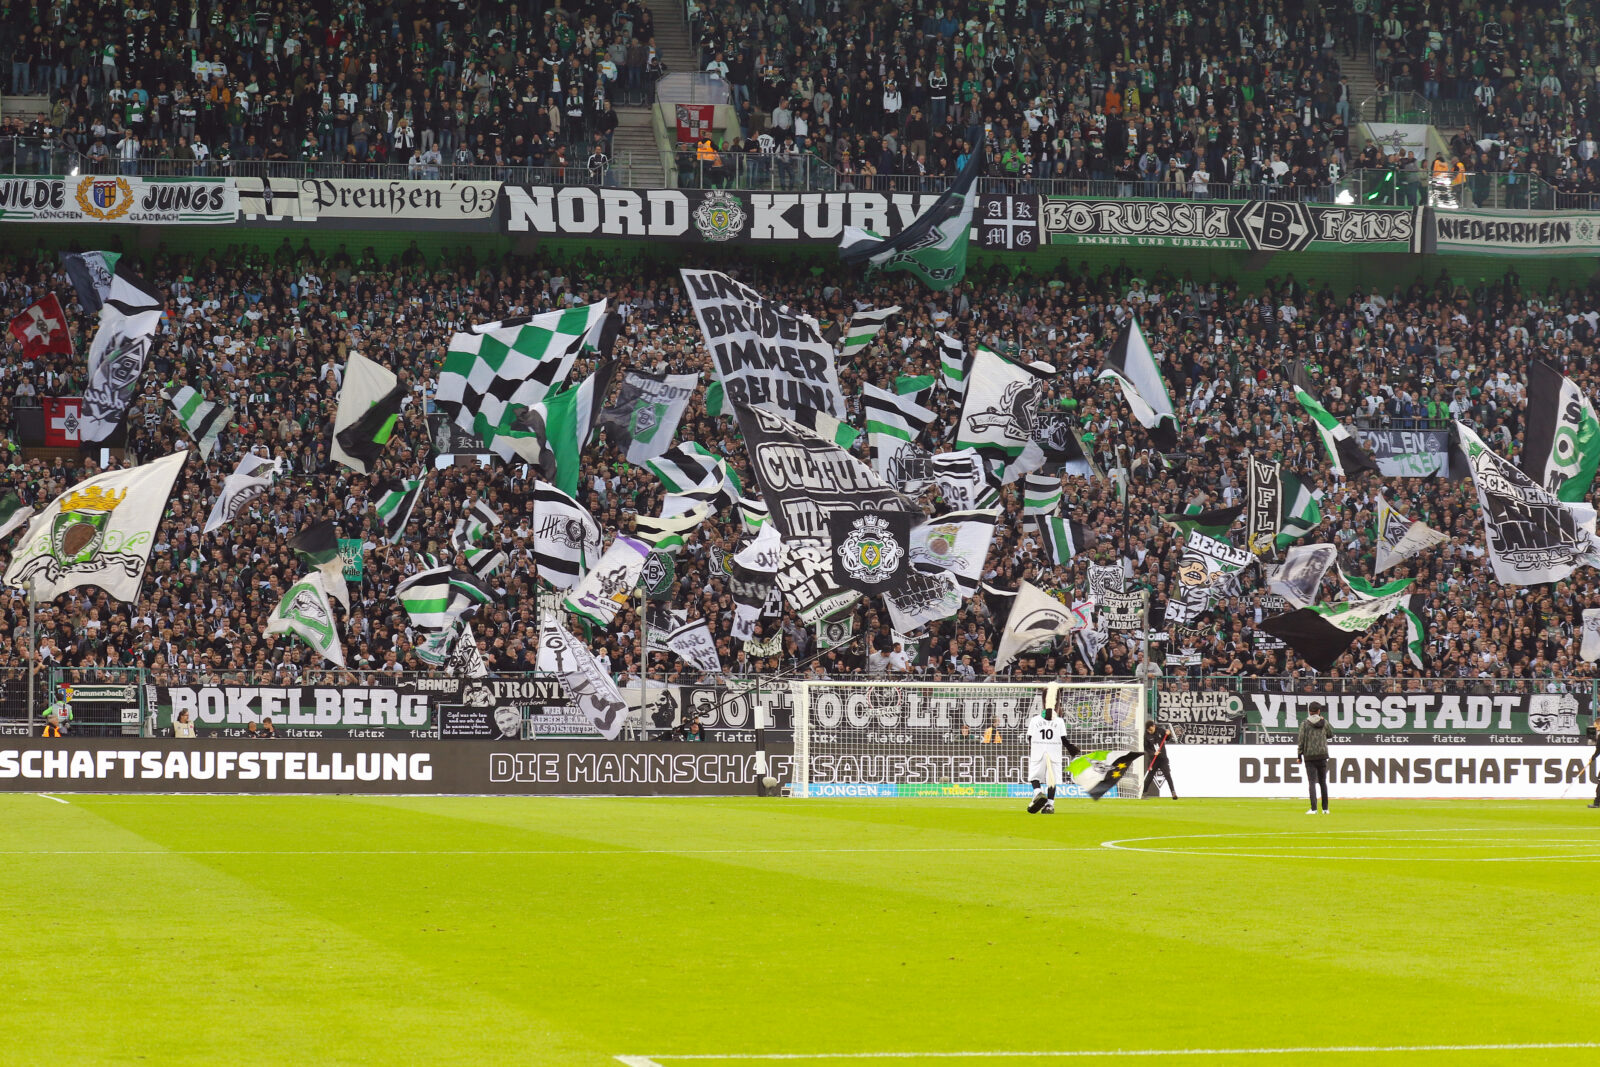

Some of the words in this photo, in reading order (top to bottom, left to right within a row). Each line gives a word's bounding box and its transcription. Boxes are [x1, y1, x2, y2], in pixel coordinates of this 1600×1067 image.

[142, 185, 224, 211] JUNGS
[33, 210, 82, 220] MÖNCHEN
[129, 213, 179, 221] GLADBACH
[504, 186, 689, 236] NORD
[750, 193, 979, 240] KURV
[1044, 202, 1231, 239] BORUSSIA
[1320, 209, 1413, 244] FANS
[1437, 217, 1571, 244] NIEDERRHEIN
[1077, 236, 1130, 245] IMMER
[1138, 237, 1166, 247] UND
[1172, 237, 1242, 248] ÜBERALL!
[714, 337, 829, 384] IMMER
[725, 374, 770, 405] BEI
[1103, 599, 1142, 609] SERVICE
[417, 679, 460, 691] BANDA
[1159, 691, 1229, 707] BEGLEIT
[1158, 706, 1226, 722] SERVICE
[286, 728, 323, 738] flatex
[348, 728, 385, 738] flatex
[1039, 728, 1054, 740] 10
[1184, 724, 1236, 737] HEUTE
[1374, 734, 1410, 743] flatex
[1432, 734, 1467, 743] flatex
[1489, 735, 1524, 744] flatex
[1546, 735, 1580, 744] flatex
[489, 753, 559, 782] DIE
[1239, 757, 1302, 783] DIE
[815, 785, 877, 796] JONGEN
